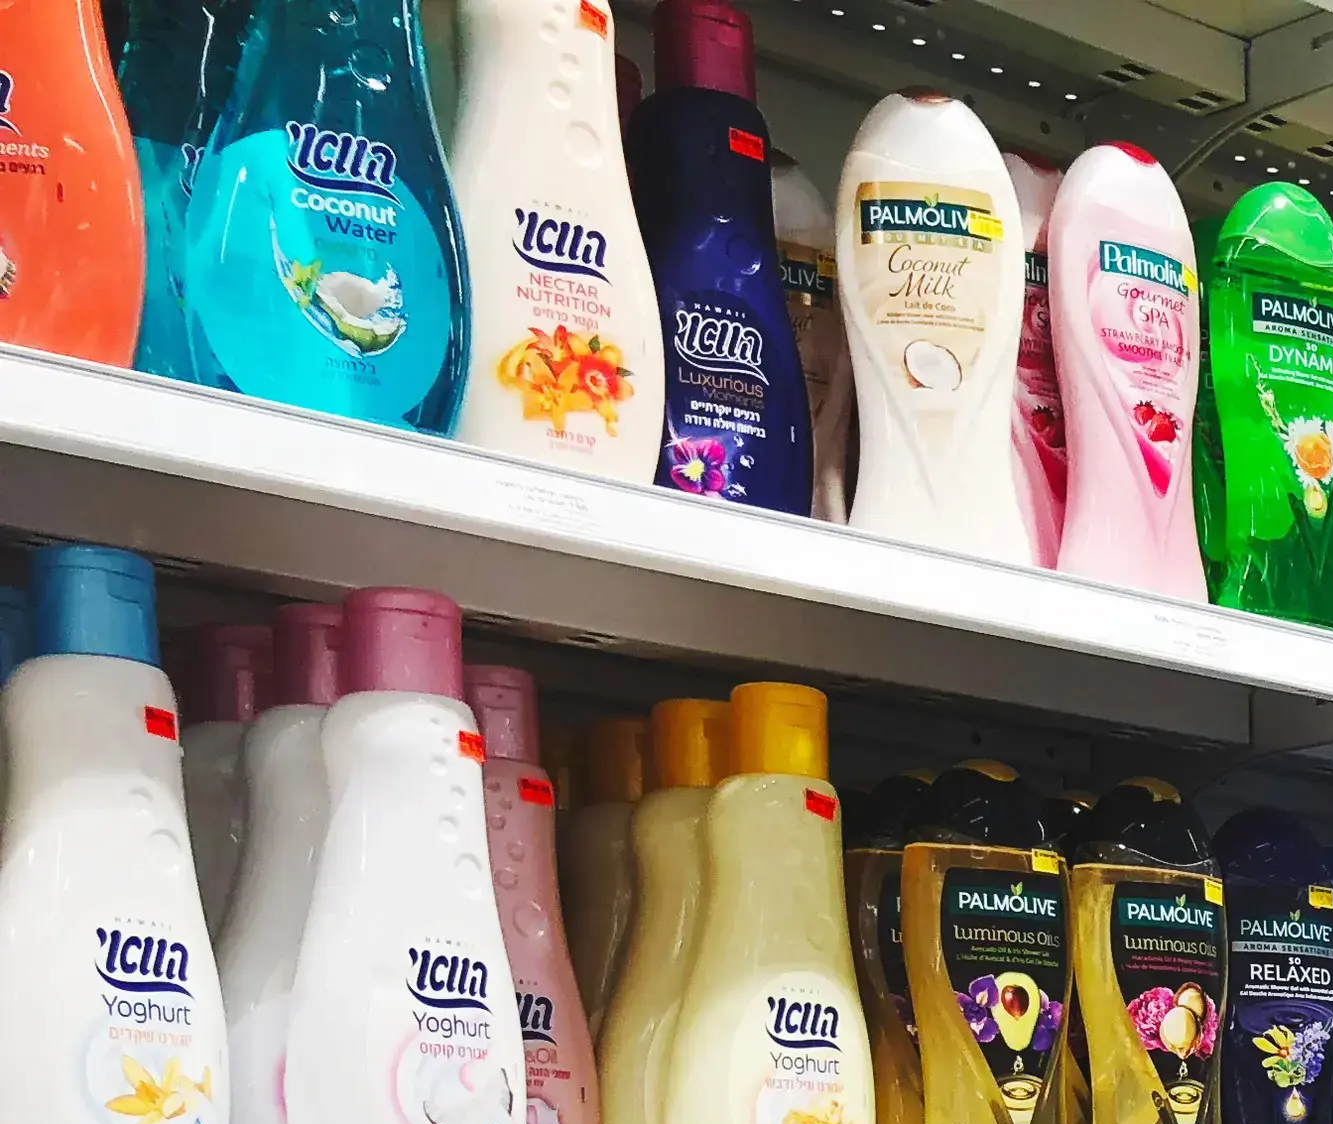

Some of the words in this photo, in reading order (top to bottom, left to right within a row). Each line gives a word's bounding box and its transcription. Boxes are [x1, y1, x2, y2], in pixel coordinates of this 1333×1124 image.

[291, 188, 397, 227] Coconut
[325, 215, 397, 246] Water
[515, 207, 607, 268] הוואי
[888, 244, 969, 275] Coconut
[529, 272, 599, 299] NECTAR
[888, 273, 955, 299] Milk
[1117, 282, 1185, 314] Gourmet
[517, 285, 611, 318] NUTRITION
[1139, 305, 1169, 329] SPA
[1265, 324, 1297, 335] AROMA
[676, 310, 763, 366] הוואי
[1306, 342, 1318, 351] SO
[678, 367, 764, 398] Luxurious
[959, 892, 1057, 917] PALMOLIVE
[1128, 903, 1214, 928] PALMOLIVE
[1240, 919, 1332, 942] PALMOLIVE
[96, 928, 188, 982] הוואי
[1243, 943, 1278, 951] AROMA
[1288, 957, 1301, 965] SO
[409, 947, 488, 998] הוואי
[1250, 963, 1331, 985] RELAXED
[102, 994, 191, 1026] Yoghurt
[767, 996, 839, 1039] הוואי
[413, 1011, 491, 1040] Yoghurt
[770, 1052, 840, 1075] Yoghurt
